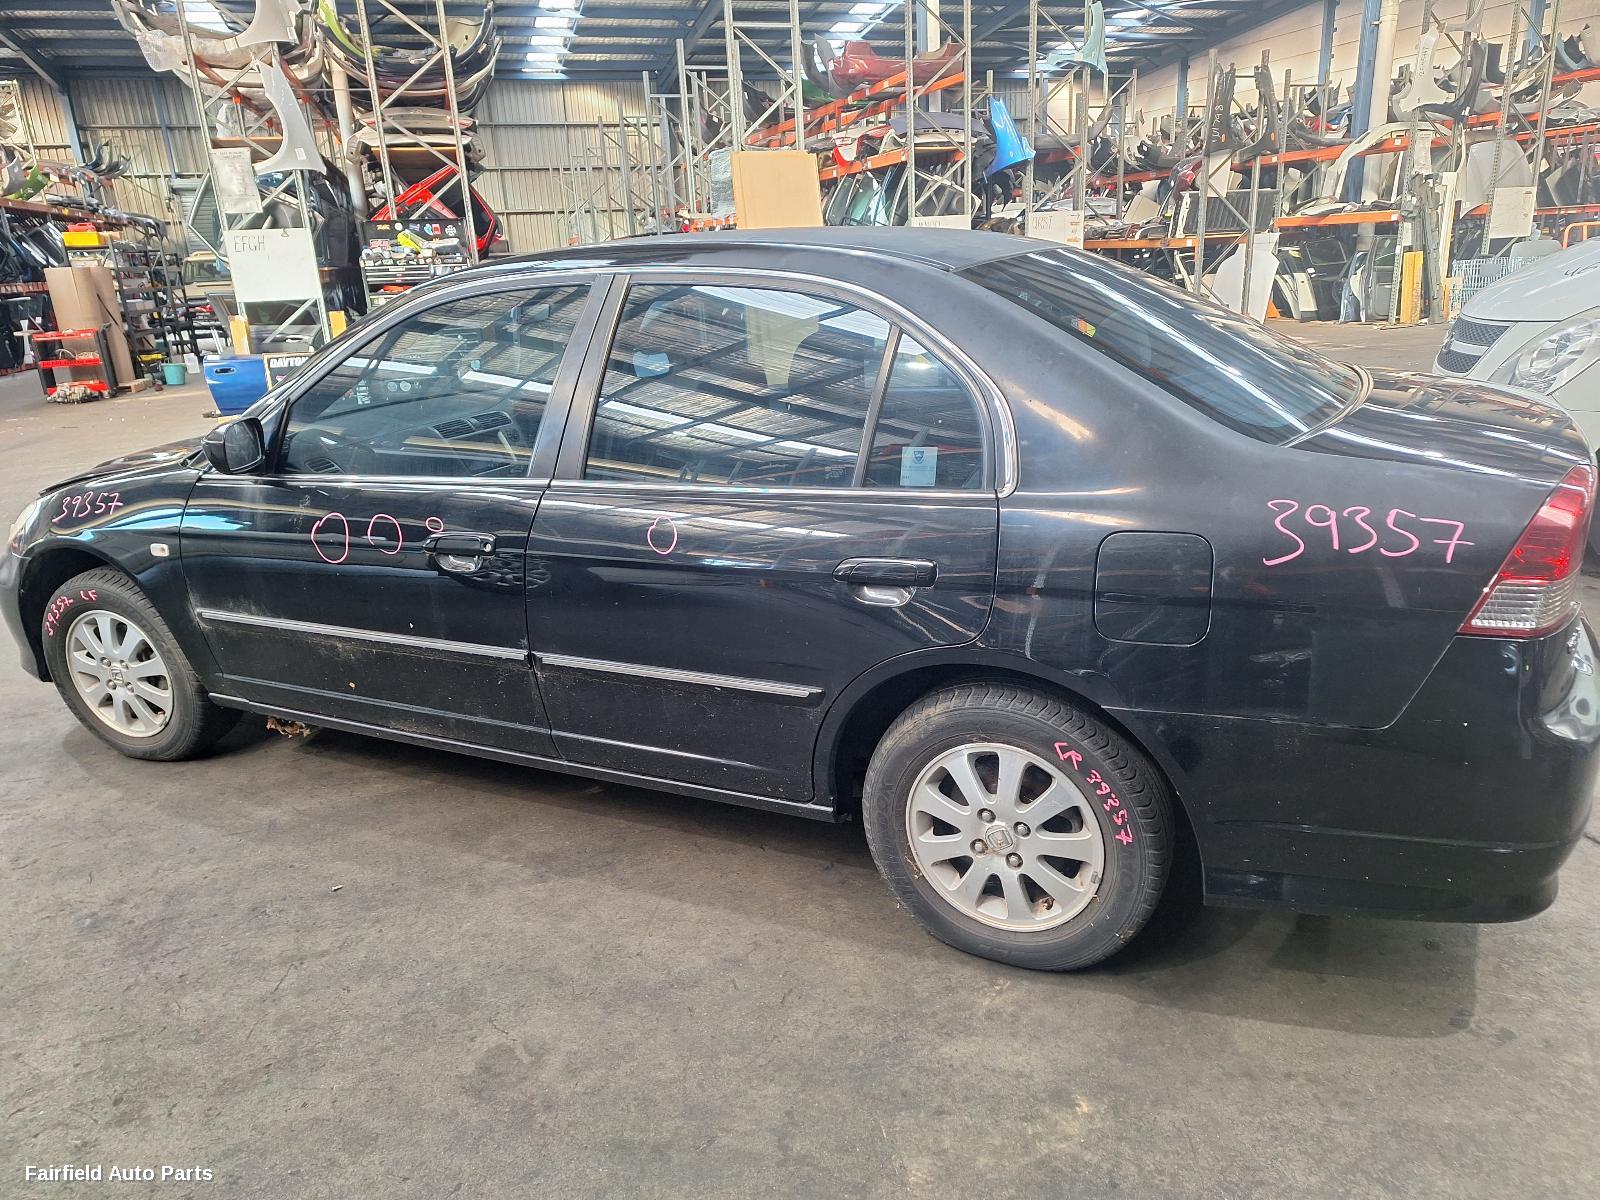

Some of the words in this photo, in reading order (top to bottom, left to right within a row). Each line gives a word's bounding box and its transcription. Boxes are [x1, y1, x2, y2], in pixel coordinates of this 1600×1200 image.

[234, 235, 265, 253] EFGH
[52, 491, 124, 523] 39357
[1262, 499, 1476, 566] 39357
